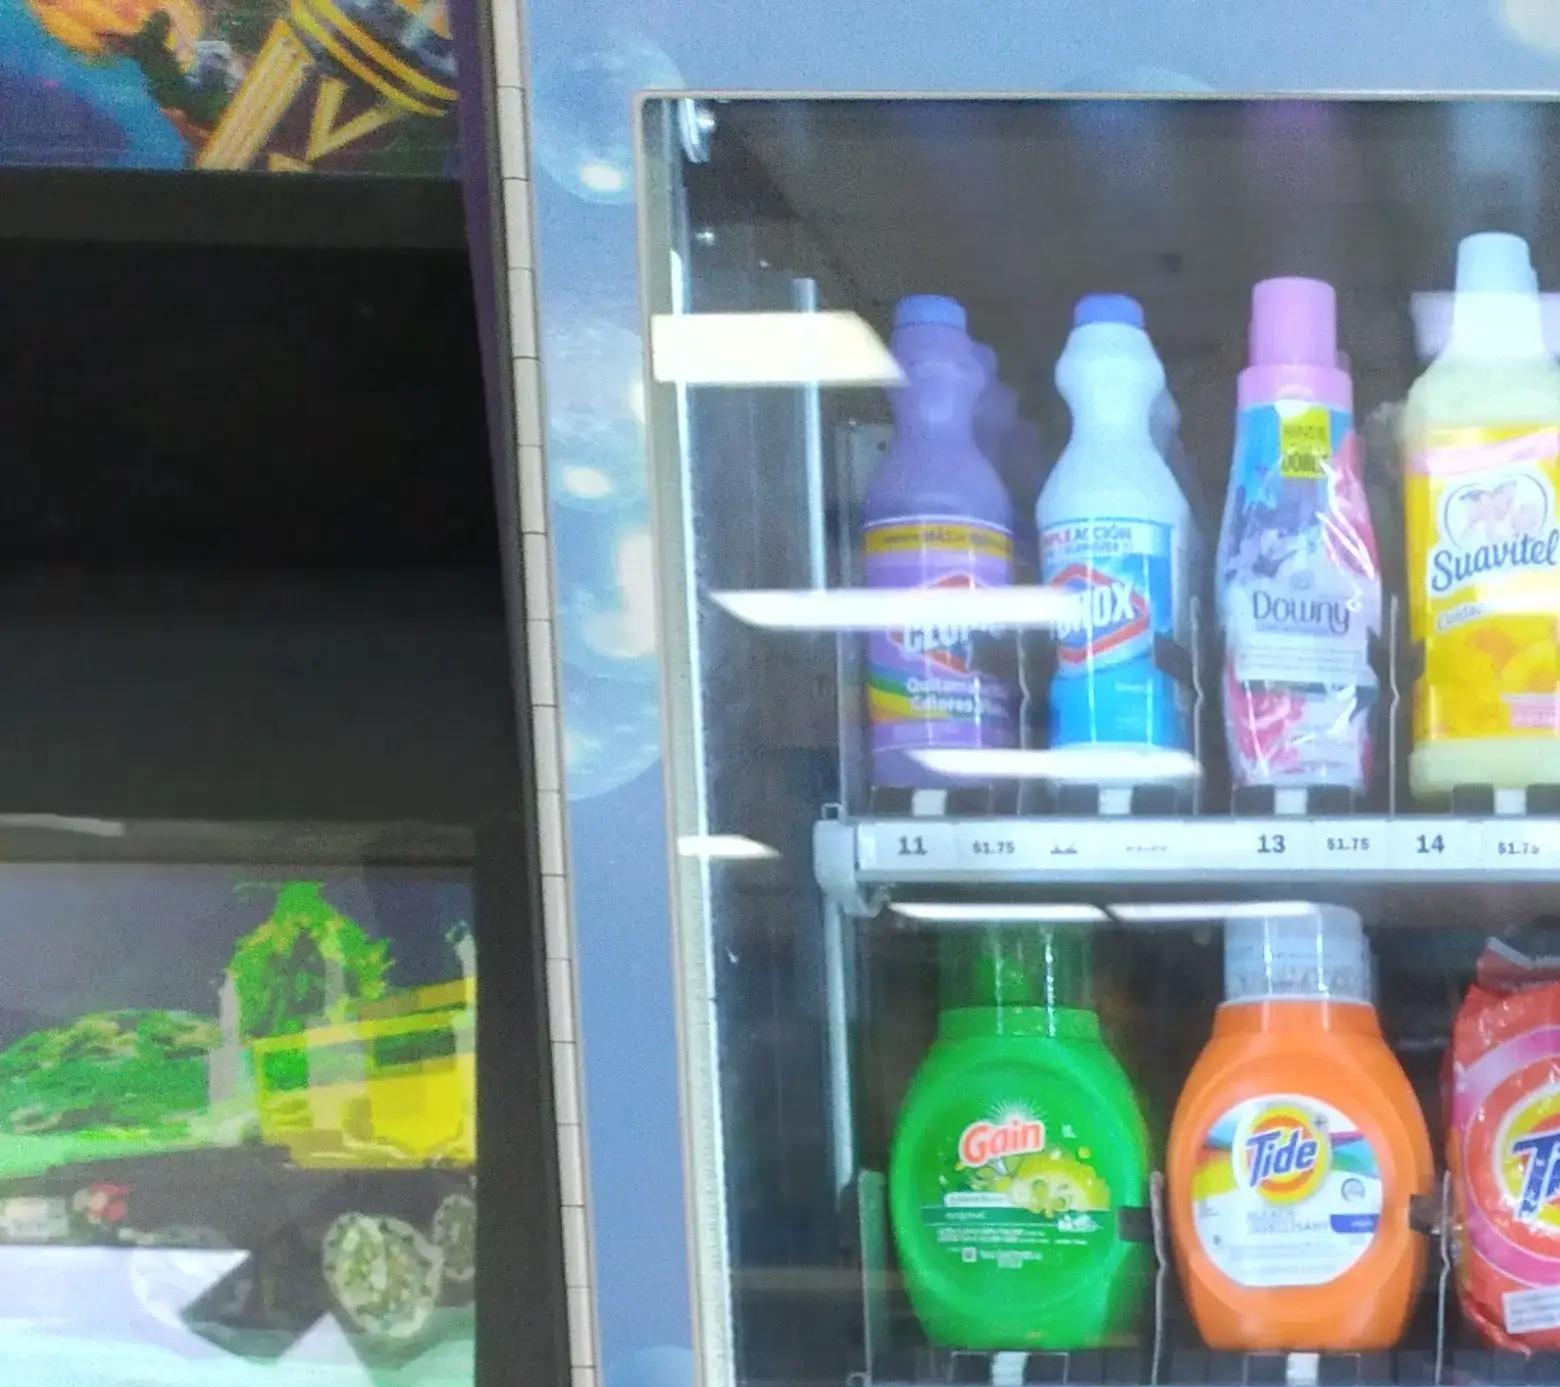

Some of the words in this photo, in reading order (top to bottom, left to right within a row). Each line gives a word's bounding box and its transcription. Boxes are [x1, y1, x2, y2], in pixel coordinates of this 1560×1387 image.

[1431, 527, 1560, 593] Suavitel
[1252, 590, 1350, 636] Downy
[897, 834, 928, 856] 11
[971, 839, 1017, 855] $1.75
[1256, 833, 1287, 854] 13
[1326, 836, 1371, 852] $1.75
[1415, 833, 1446, 854] 14
[961, 1118, 1044, 1166] Gain
[1245, 1126, 1319, 1188] Tide
